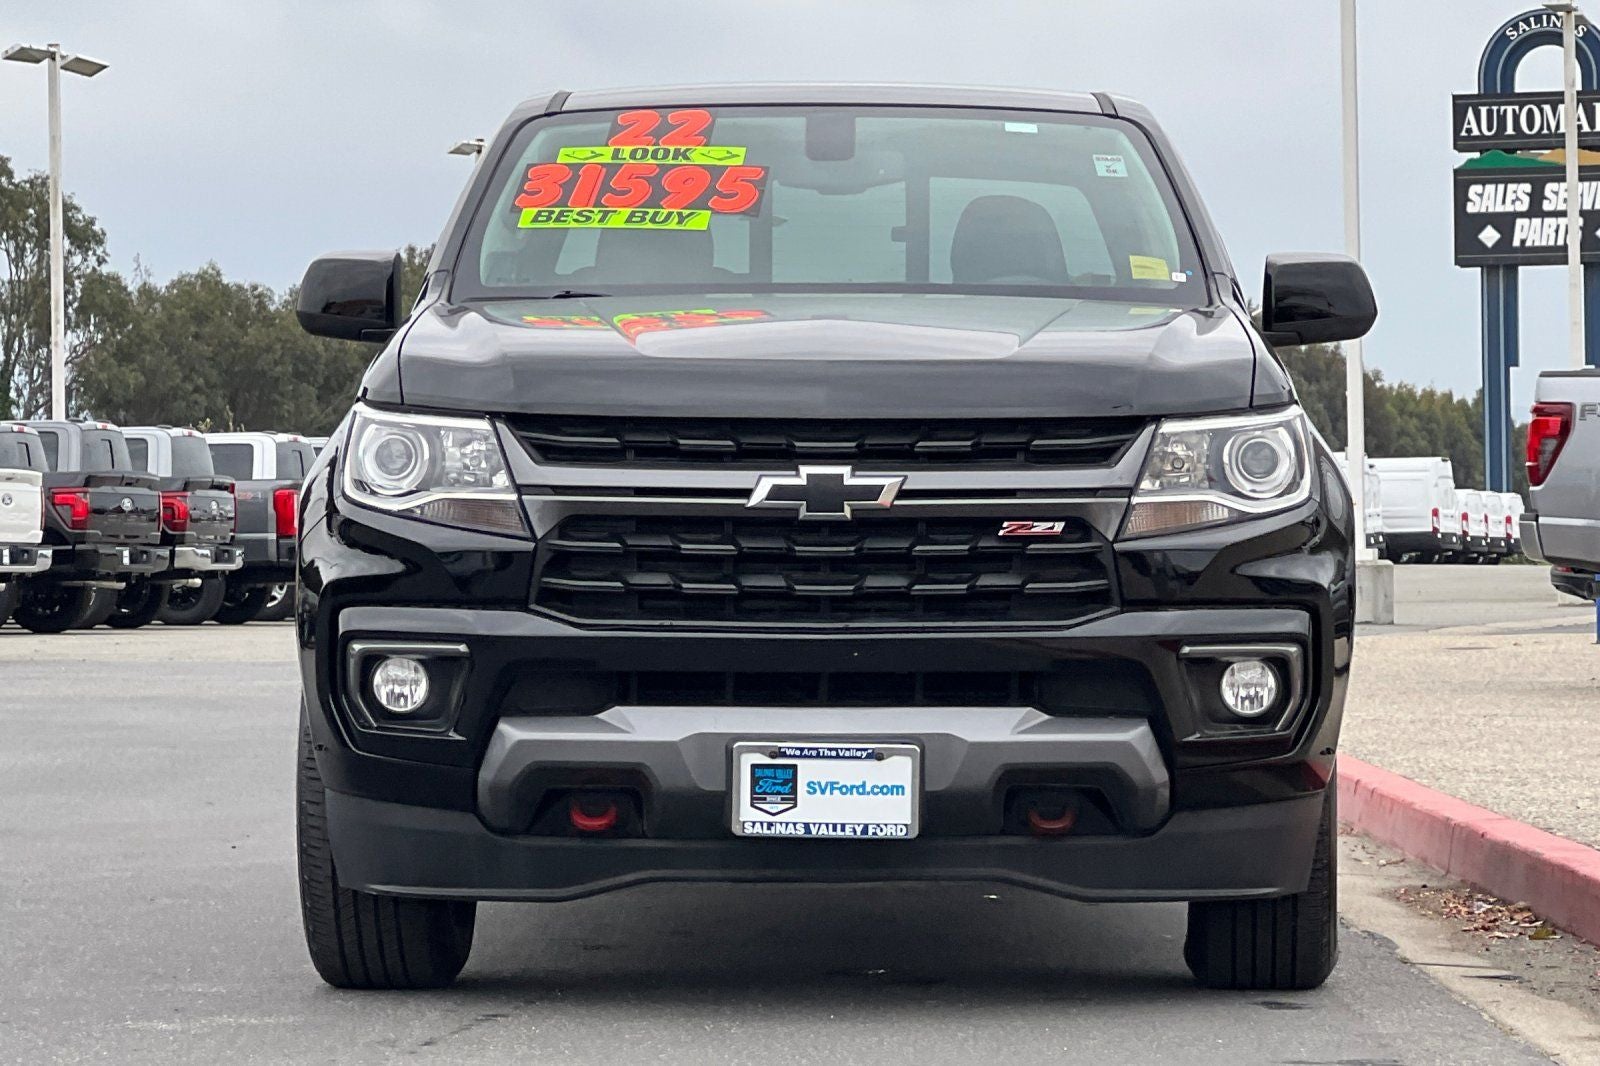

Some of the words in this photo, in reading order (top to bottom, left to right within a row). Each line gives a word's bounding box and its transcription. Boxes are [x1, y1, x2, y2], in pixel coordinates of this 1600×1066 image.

[1505, 14, 1588, 41] SALINS
[607, 109, 713, 147] 22
[610, 147, 696, 163] LOOK
[514, 163, 765, 213] 31595
[1466, 182, 1532, 214] SALES
[531, 209, 620, 224] BEST
[623, 209, 704, 226] BUY
[998, 521, 1066, 536] Z71
[802, 748, 817, 757] Are
[818, 748, 837, 757] The
[806, 781, 906, 797] SVFord.com
[809, 823, 865, 836] VALLEY
[868, 825, 907, 836] FORD
